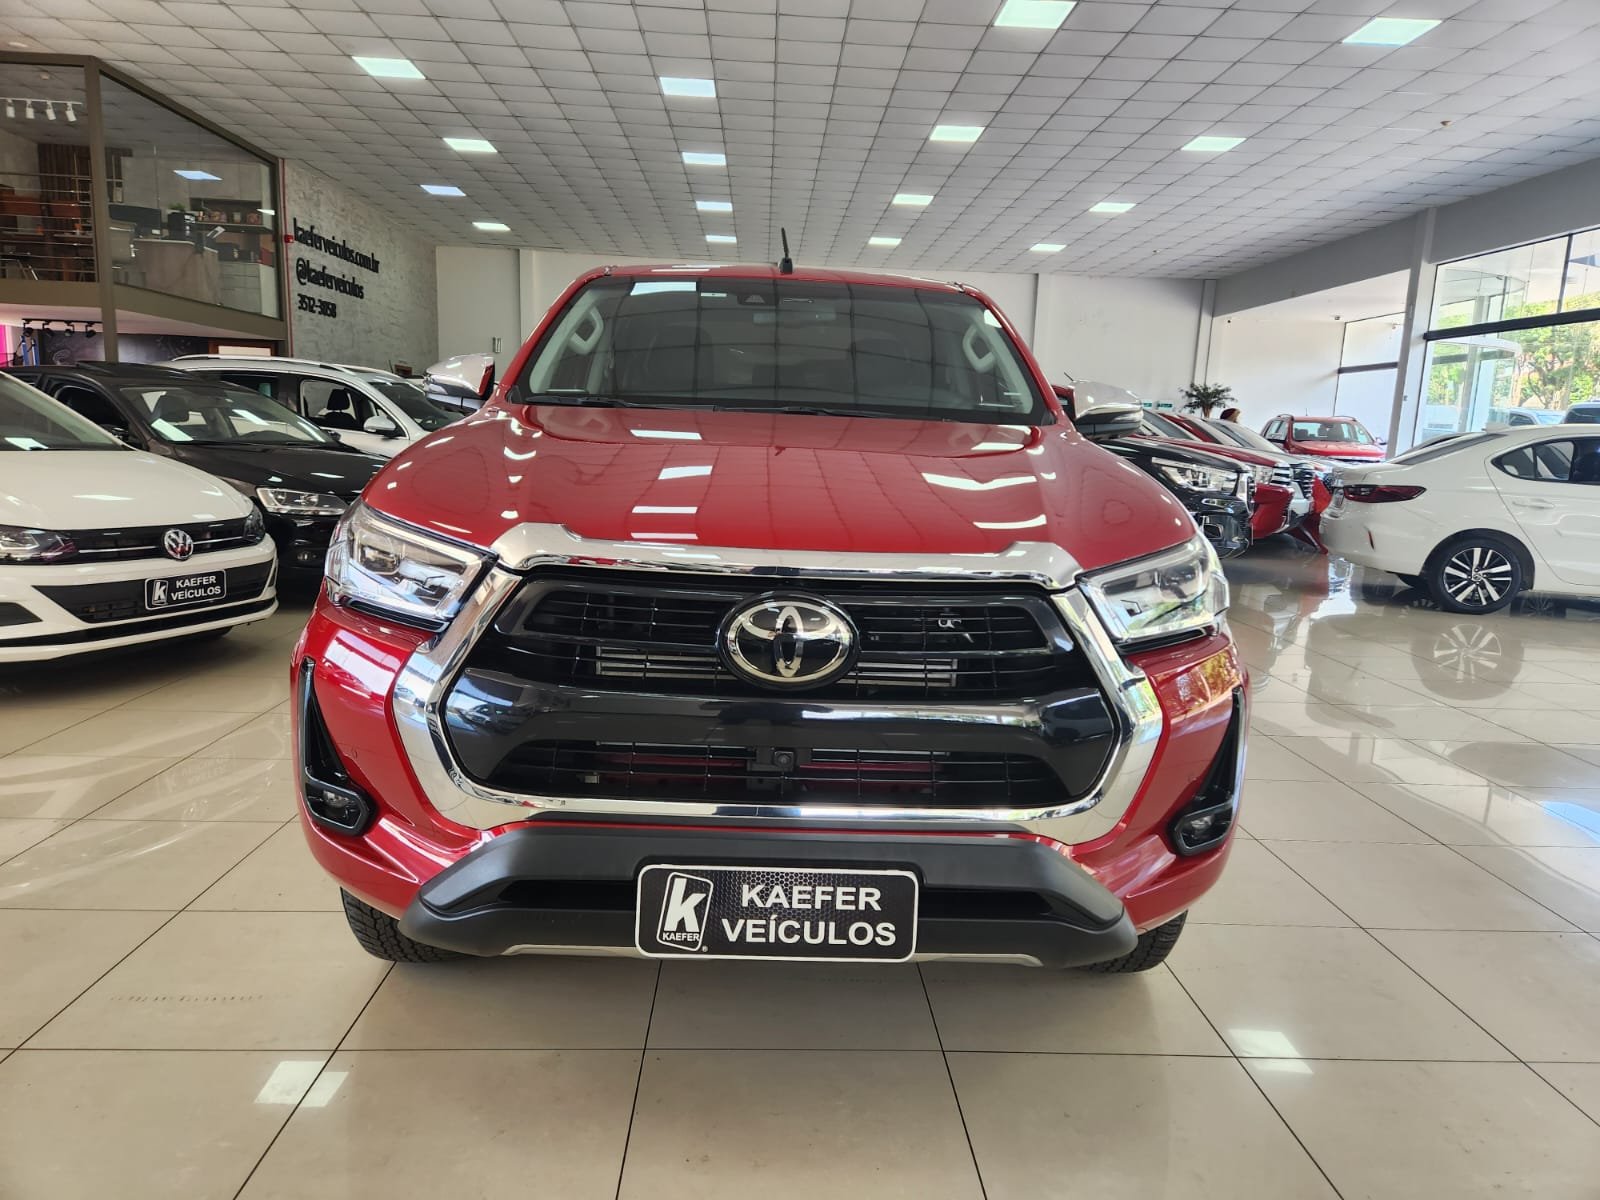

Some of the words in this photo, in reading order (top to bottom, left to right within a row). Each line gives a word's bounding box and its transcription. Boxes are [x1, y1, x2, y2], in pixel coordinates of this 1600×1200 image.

[176, 576, 216, 588] KAEFER
[741, 884, 882, 911] KAEFER
[662, 932, 701, 942] KAEFER
[721, 914, 897, 946] VEÍCULOS
